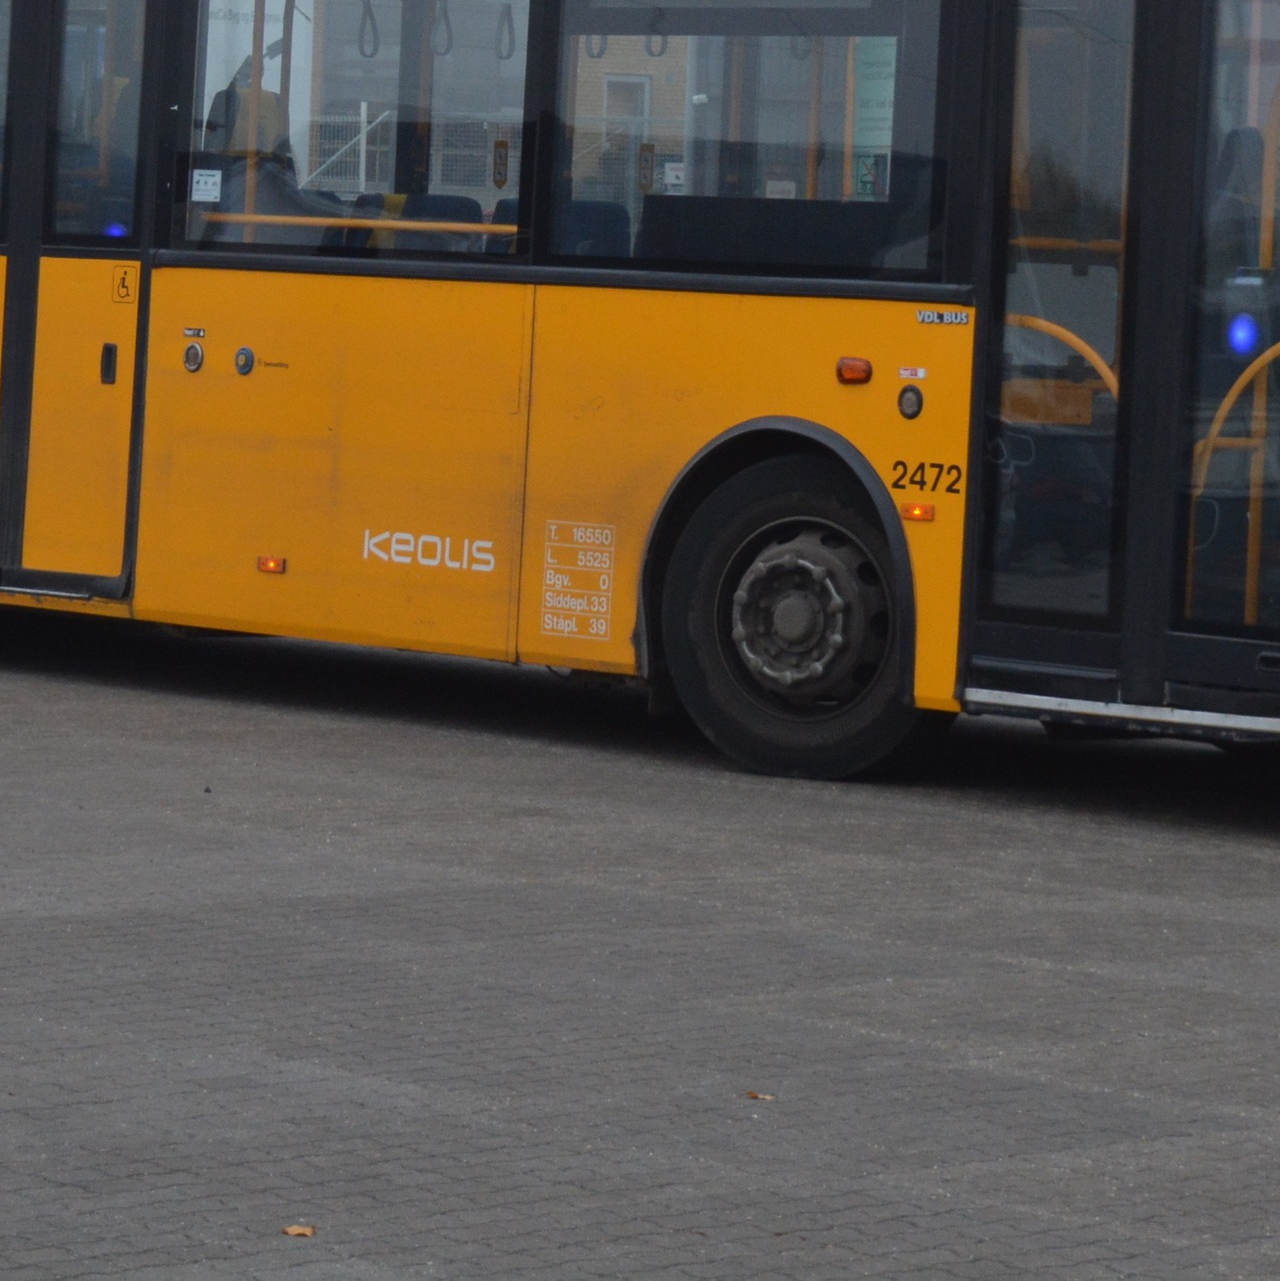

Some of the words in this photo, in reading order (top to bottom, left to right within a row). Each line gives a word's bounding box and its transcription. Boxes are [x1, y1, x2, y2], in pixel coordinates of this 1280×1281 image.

[916, 310, 941, 324] VDL
[943, 311, 969, 325] BUS
[891, 459, 962, 494] 2472
[549, 525, 559, 540] T.
[572, 527, 612, 545] 16550
[547, 547, 558, 564] L.
[577, 550, 610, 568] 5525
[546, 569, 571, 589] Bgv.
[599, 574, 609, 590] 0
[544, 591, 589, 613] Siddepl.
[590, 596, 608, 612] 33
[543, 613, 578, 634] Ståpl.
[589, 618, 607, 634] 39
